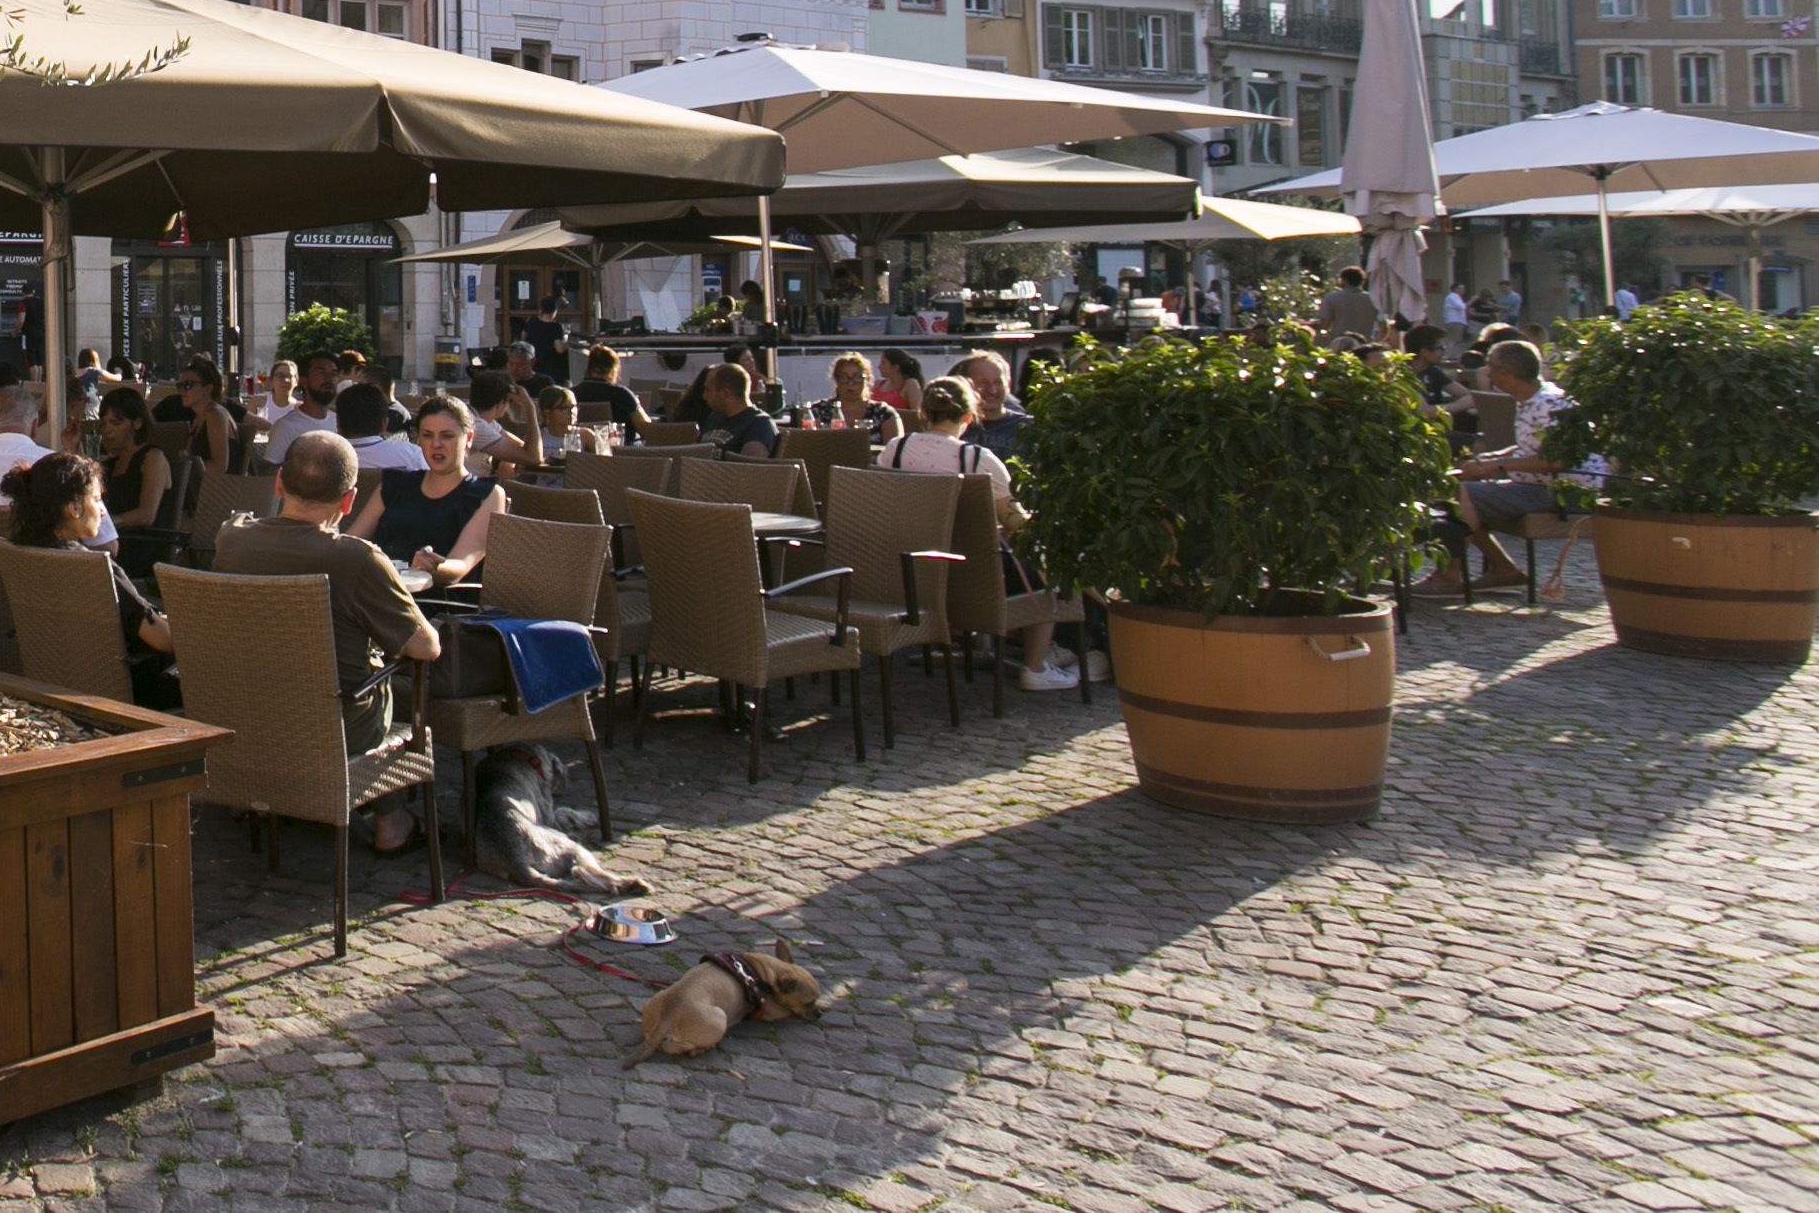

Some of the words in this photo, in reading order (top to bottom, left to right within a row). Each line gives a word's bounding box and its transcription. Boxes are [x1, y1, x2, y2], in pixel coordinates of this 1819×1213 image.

[294, 234, 331, 244] CAISSE
[335, 234, 393, 245] D'EPARGNE
[4, 255, 42, 264] AUTOMAT
